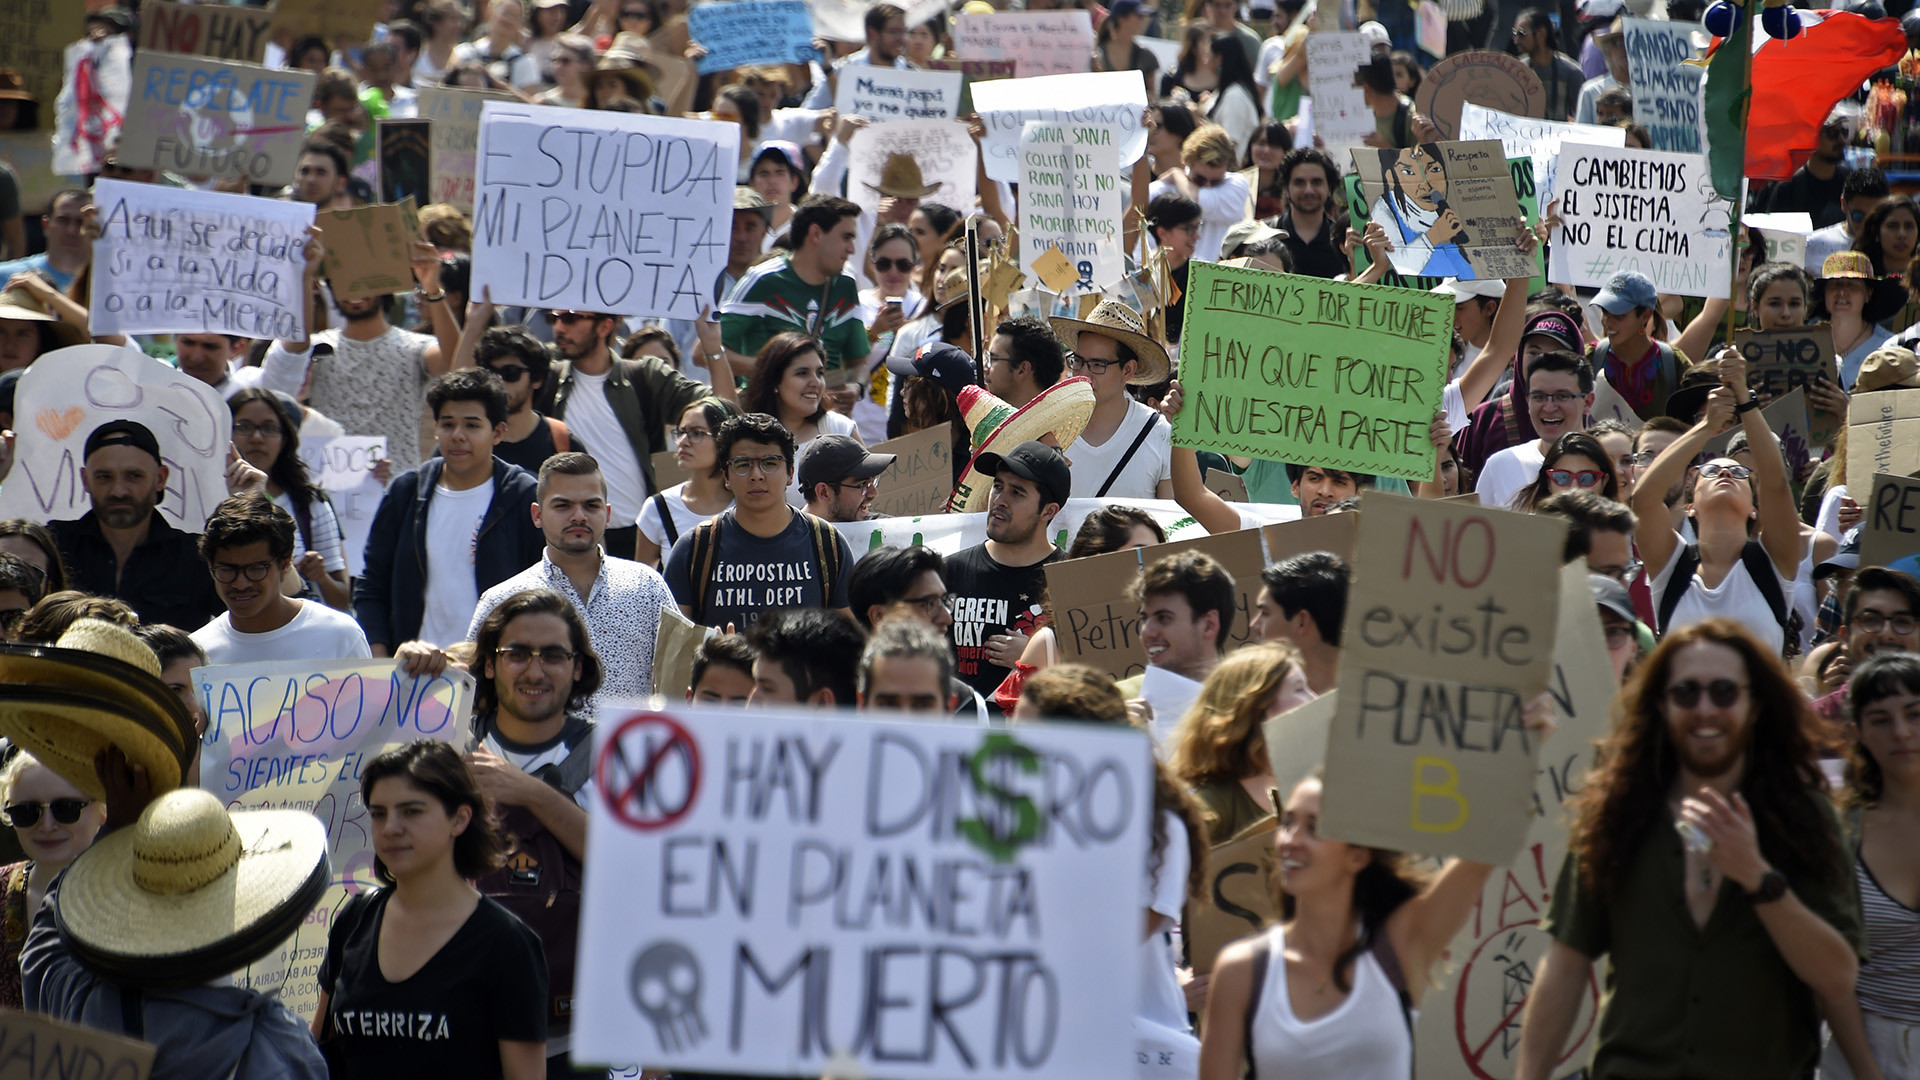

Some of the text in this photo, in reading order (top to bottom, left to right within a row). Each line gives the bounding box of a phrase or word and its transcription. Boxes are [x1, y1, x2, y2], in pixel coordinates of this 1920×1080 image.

[150, 6, 270, 60] NO HAY
[1627, 27, 1689, 66] CAMBIO
[1029, 127, 1112, 146] SANA SANA
[1448, 148, 1489, 163] Respeta
[153, 136, 272, 178] FUTURO
[483, 111, 722, 204] ESTÚPIDA
[1026, 151, 1069, 170] COLITA
[1075, 153, 1093, 169] DE
[1468, 162, 1478, 173] la
[1573, 157, 1687, 193] CAMBIEMOS
[1029, 193, 1100, 211] SANA HOY
[1074, 176, 1088, 191] SI
[1095, 175, 1115, 191] NO
[473, 187, 522, 247] MI
[541, 196, 726, 263] PLANETA
[1030, 214, 1116, 236] MORIREMOS
[1562, 189, 1580, 216] EL
[1593, 192, 1676, 226] SISTEMA,
[187, 221, 218, 248] se
[227, 225, 304, 263] decide
[1562, 222, 1689, 257] NO EL CLIMA
[147, 253, 164, 271] a
[178, 256, 198, 274] la
[1650, 260, 1708, 290] VEGAN
[136, 295, 151, 312] a
[165, 289, 187, 312] la
[523, 252, 703, 315] IDIOTA
[1209, 279, 1438, 340] FRIDAY'S FOR FUTURE
[1202, 331, 1425, 405] HAY QUE PONER
[1195, 391, 1428, 456] NUESTRA PARTE
[1403, 515, 1497, 589] NO
[954, 597, 1009, 626] GREEN
[954, 622, 985, 647] DAY
[1360, 596, 1534, 667] existe
[379, 670, 456, 734] NO
[1357, 669, 1532, 755] PLANETA
[226, 752, 329, 791] SIENTES
[604, 732, 693, 817] NO
[721, 733, 842, 826] HAY
[1409, 755, 1471, 834] B
[660, 836, 1042, 940] EN PLANETA
[728, 940, 1060, 1070] MUERTO
[333, 1011, 450, 1041] ATERRIZA
